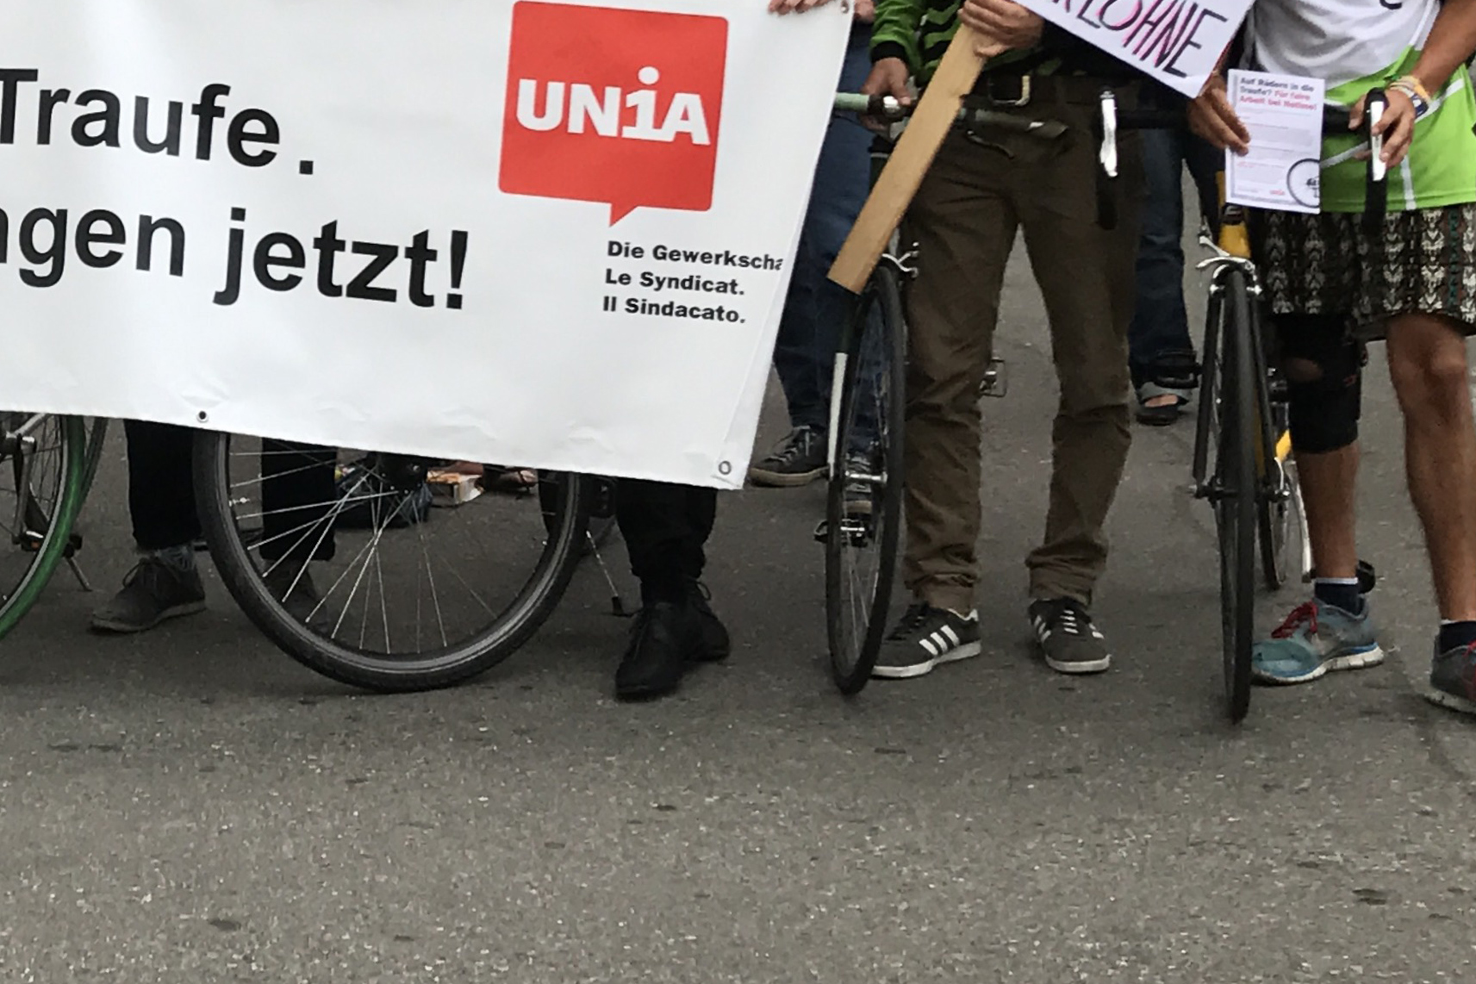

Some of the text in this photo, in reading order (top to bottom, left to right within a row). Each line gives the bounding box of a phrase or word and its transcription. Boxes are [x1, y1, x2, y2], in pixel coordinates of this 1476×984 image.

[212, 206, 470, 310] jetzt!
[606, 240, 646, 260] Die
[604, 267, 745, 296] Le Syndicat.
[624, 296, 747, 324] Sindacato.
